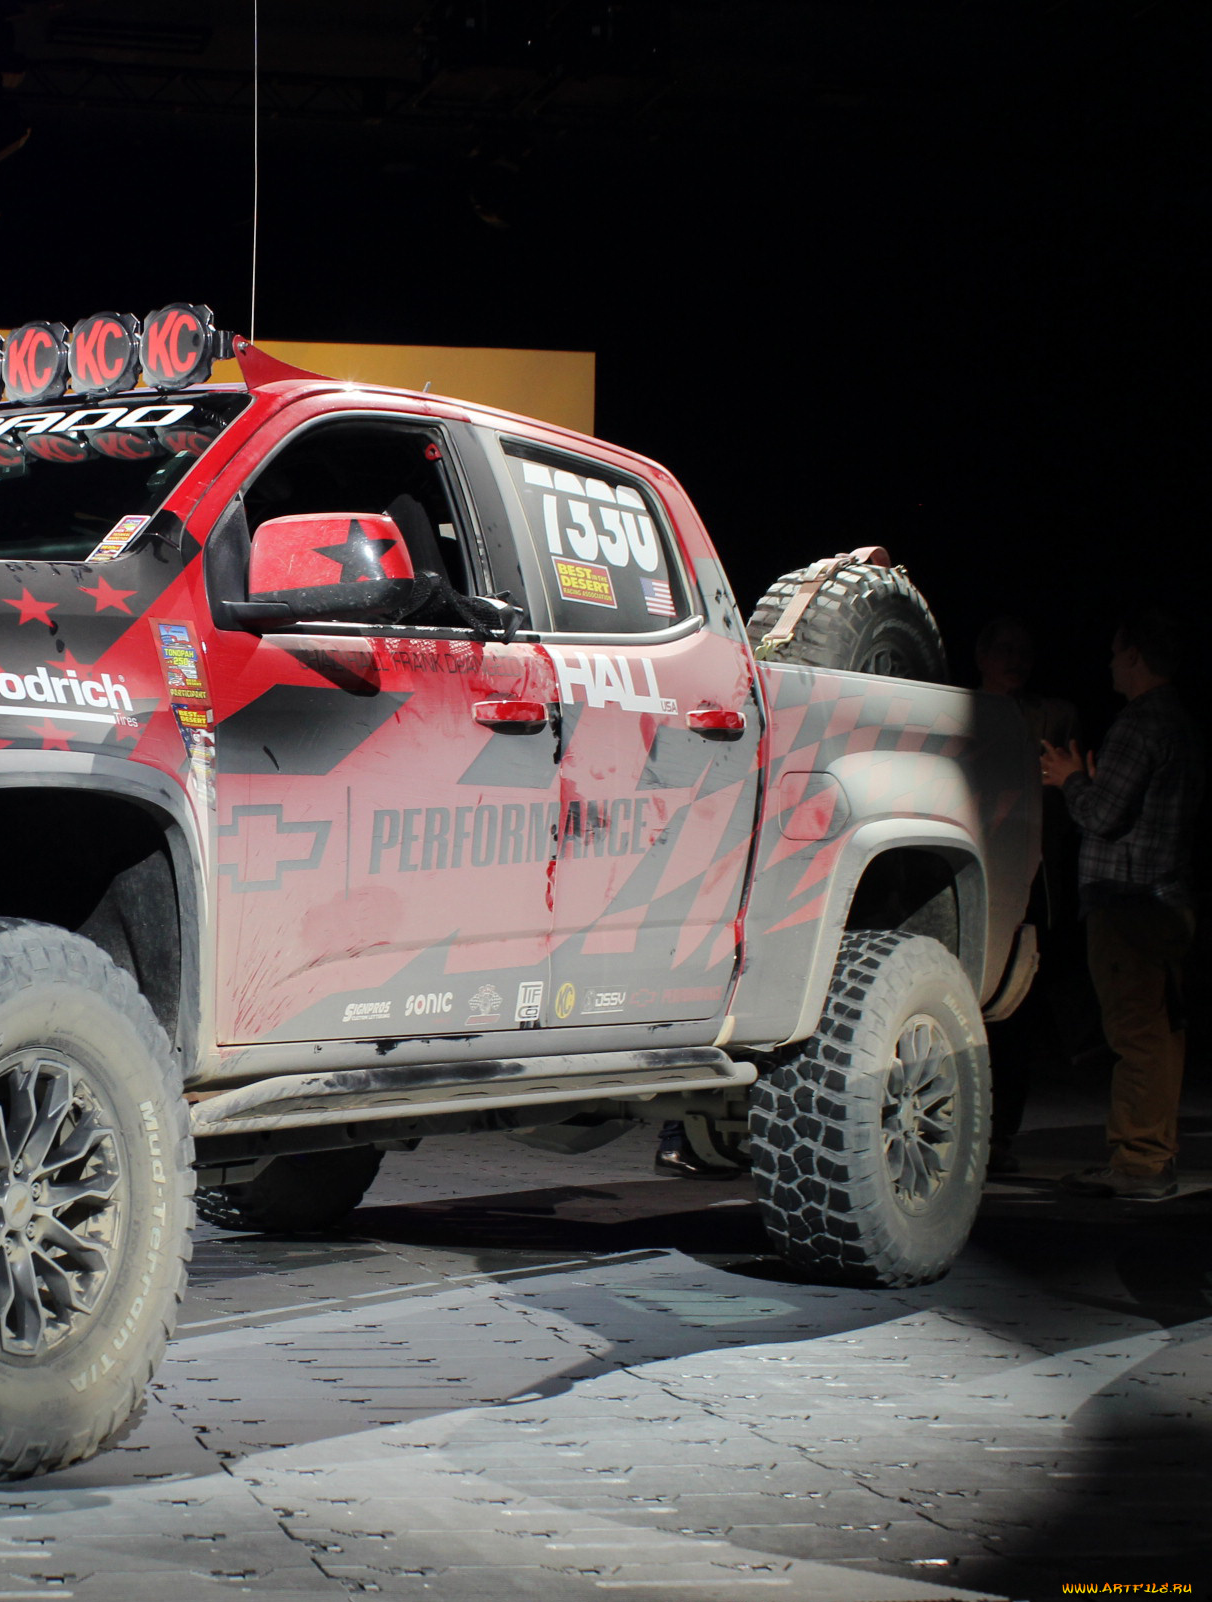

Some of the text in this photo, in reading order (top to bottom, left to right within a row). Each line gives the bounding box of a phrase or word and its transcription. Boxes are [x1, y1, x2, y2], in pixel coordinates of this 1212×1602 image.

[8, 328, 53, 393] KC
[76, 320, 125, 386] KC
[148, 310, 198, 378] KC
[522, 462, 658, 571] 7330
[557, 562, 592, 580] BEST
[560, 574, 610, 594] DESERT
[390, 650, 444, 674] FRANK
[553, 650, 678, 715] HALL
[114, 711, 138, 728] Tires
[661, 701, 677, 713] USA
[368, 797, 650, 875] PERFORMANCE
[594, 991, 626, 1006] DSSV
